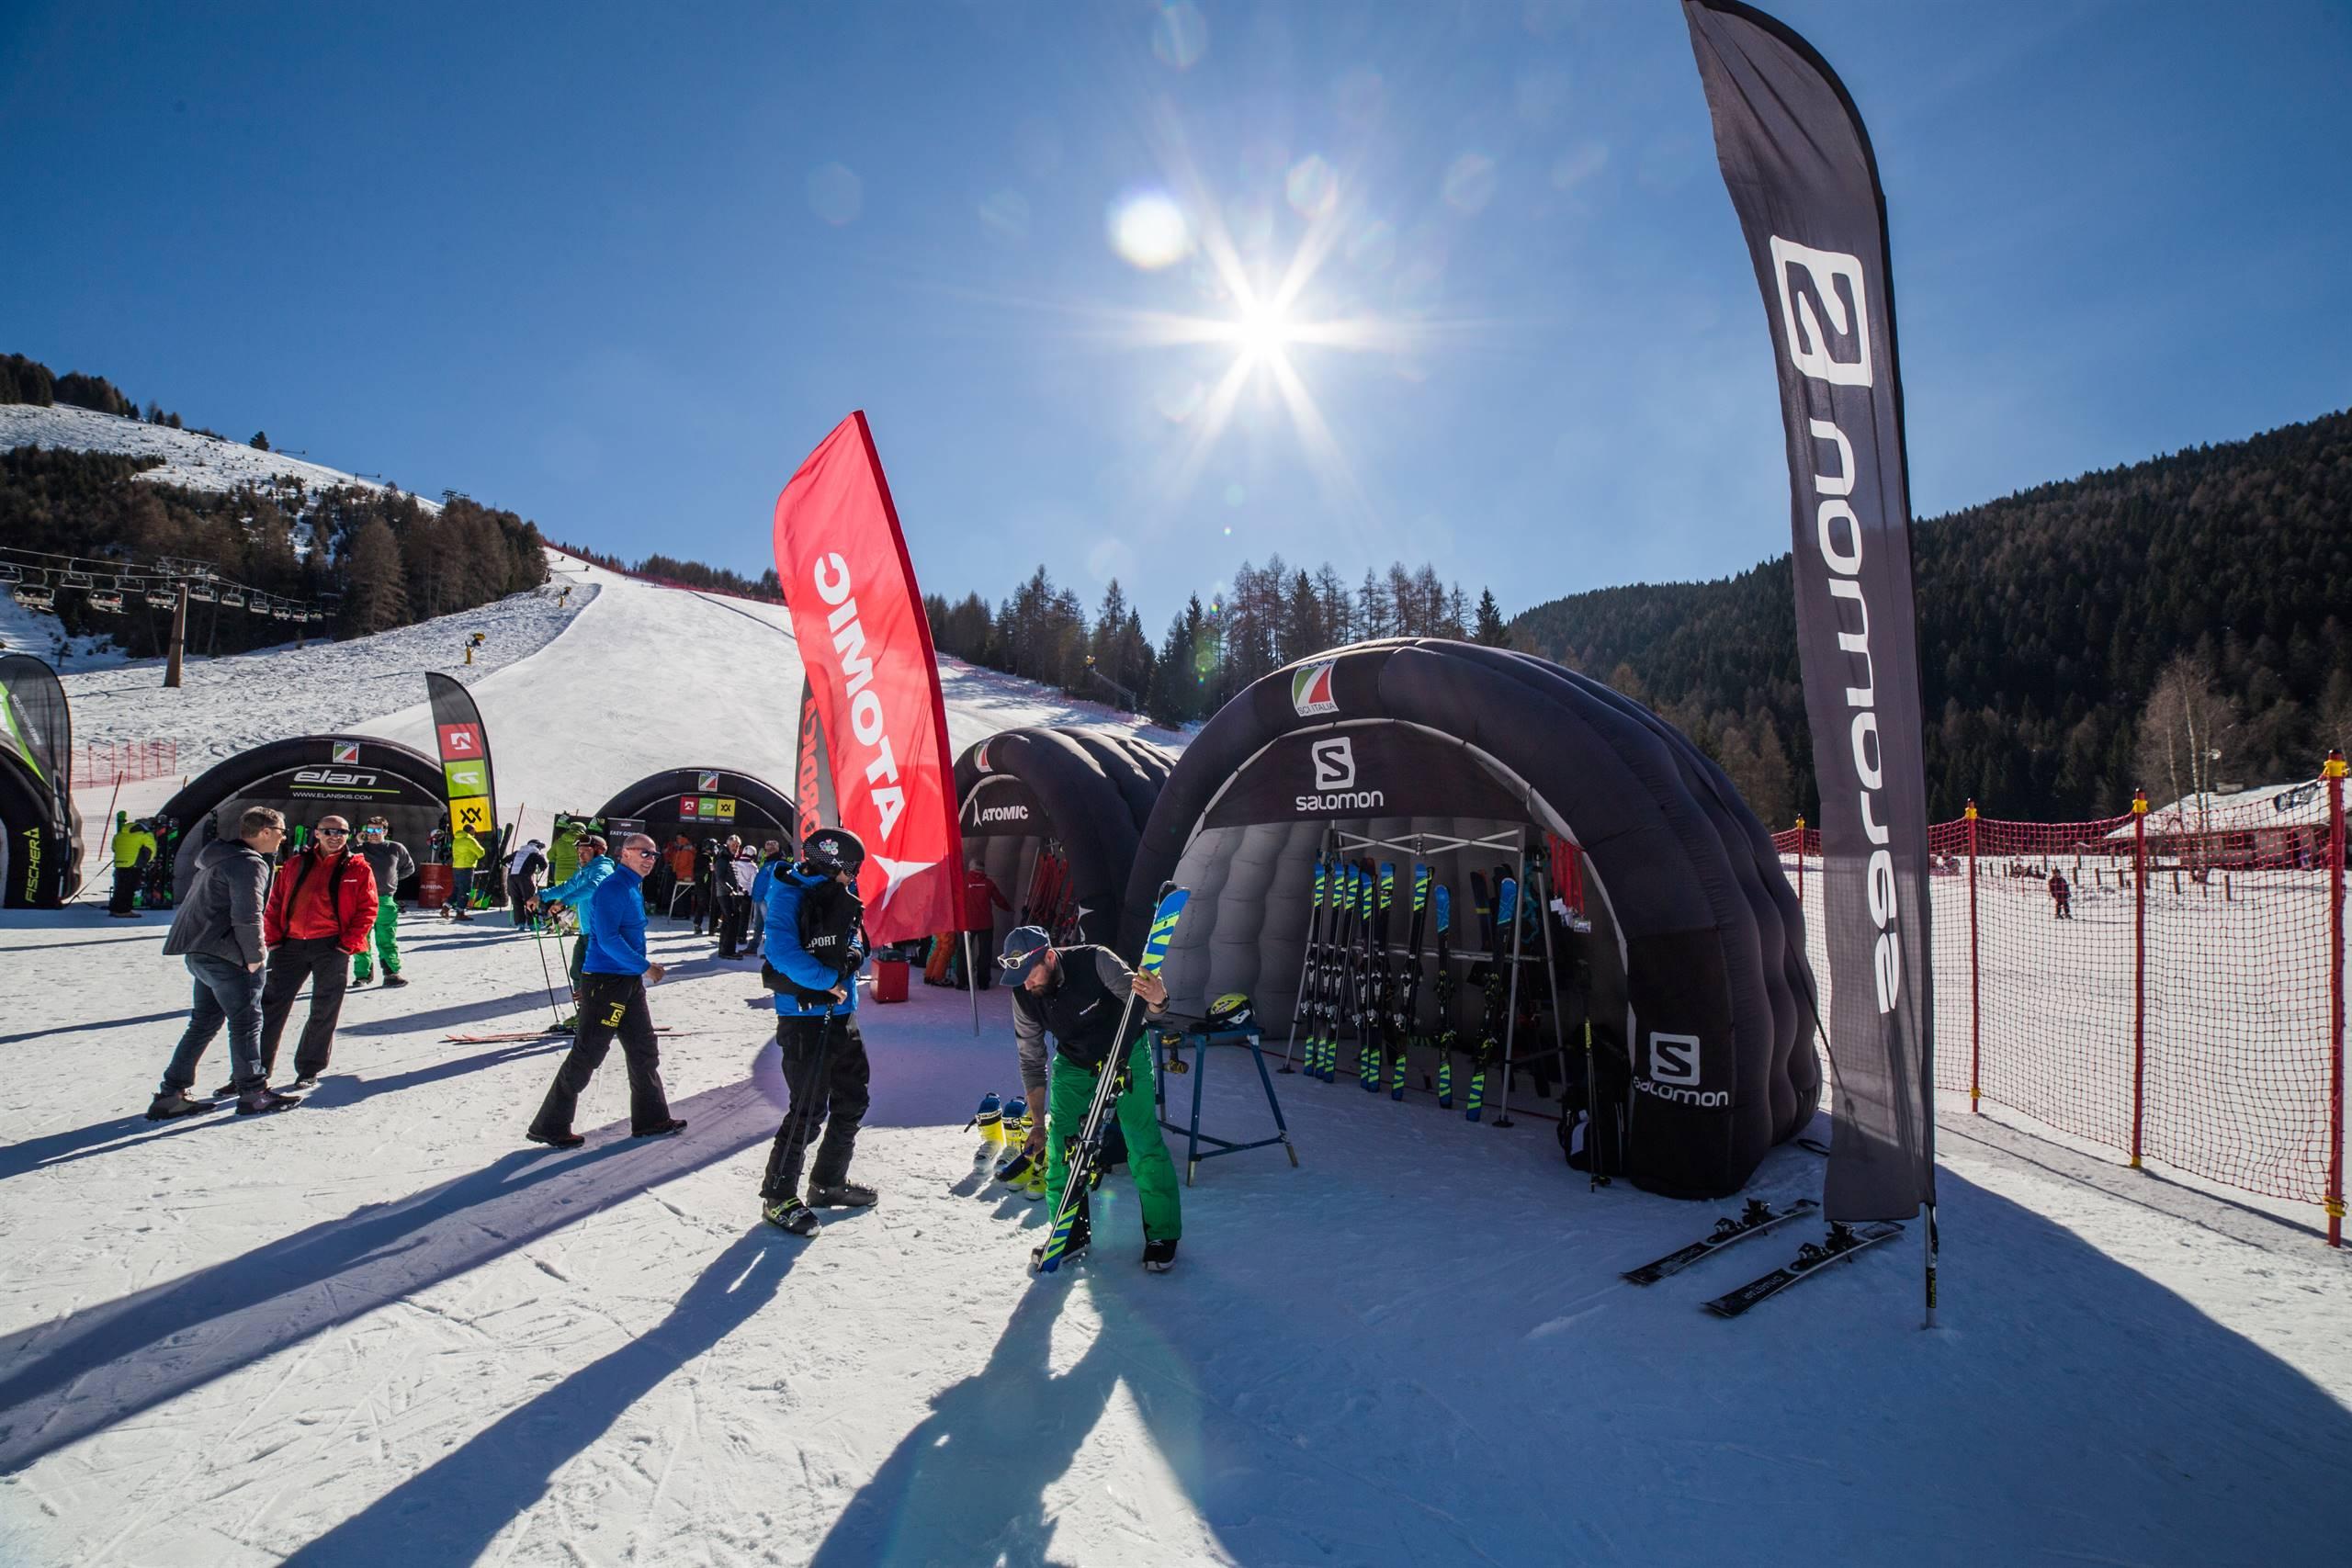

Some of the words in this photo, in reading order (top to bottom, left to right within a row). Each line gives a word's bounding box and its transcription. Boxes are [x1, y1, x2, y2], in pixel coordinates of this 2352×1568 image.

[293, 770, 377, 786] elan
[292, 792, 372, 801] WWW.ELANSKIS.COM
[981, 806, 1029, 822] ATOMIC
[25, 839, 40, 903] FISCHER
